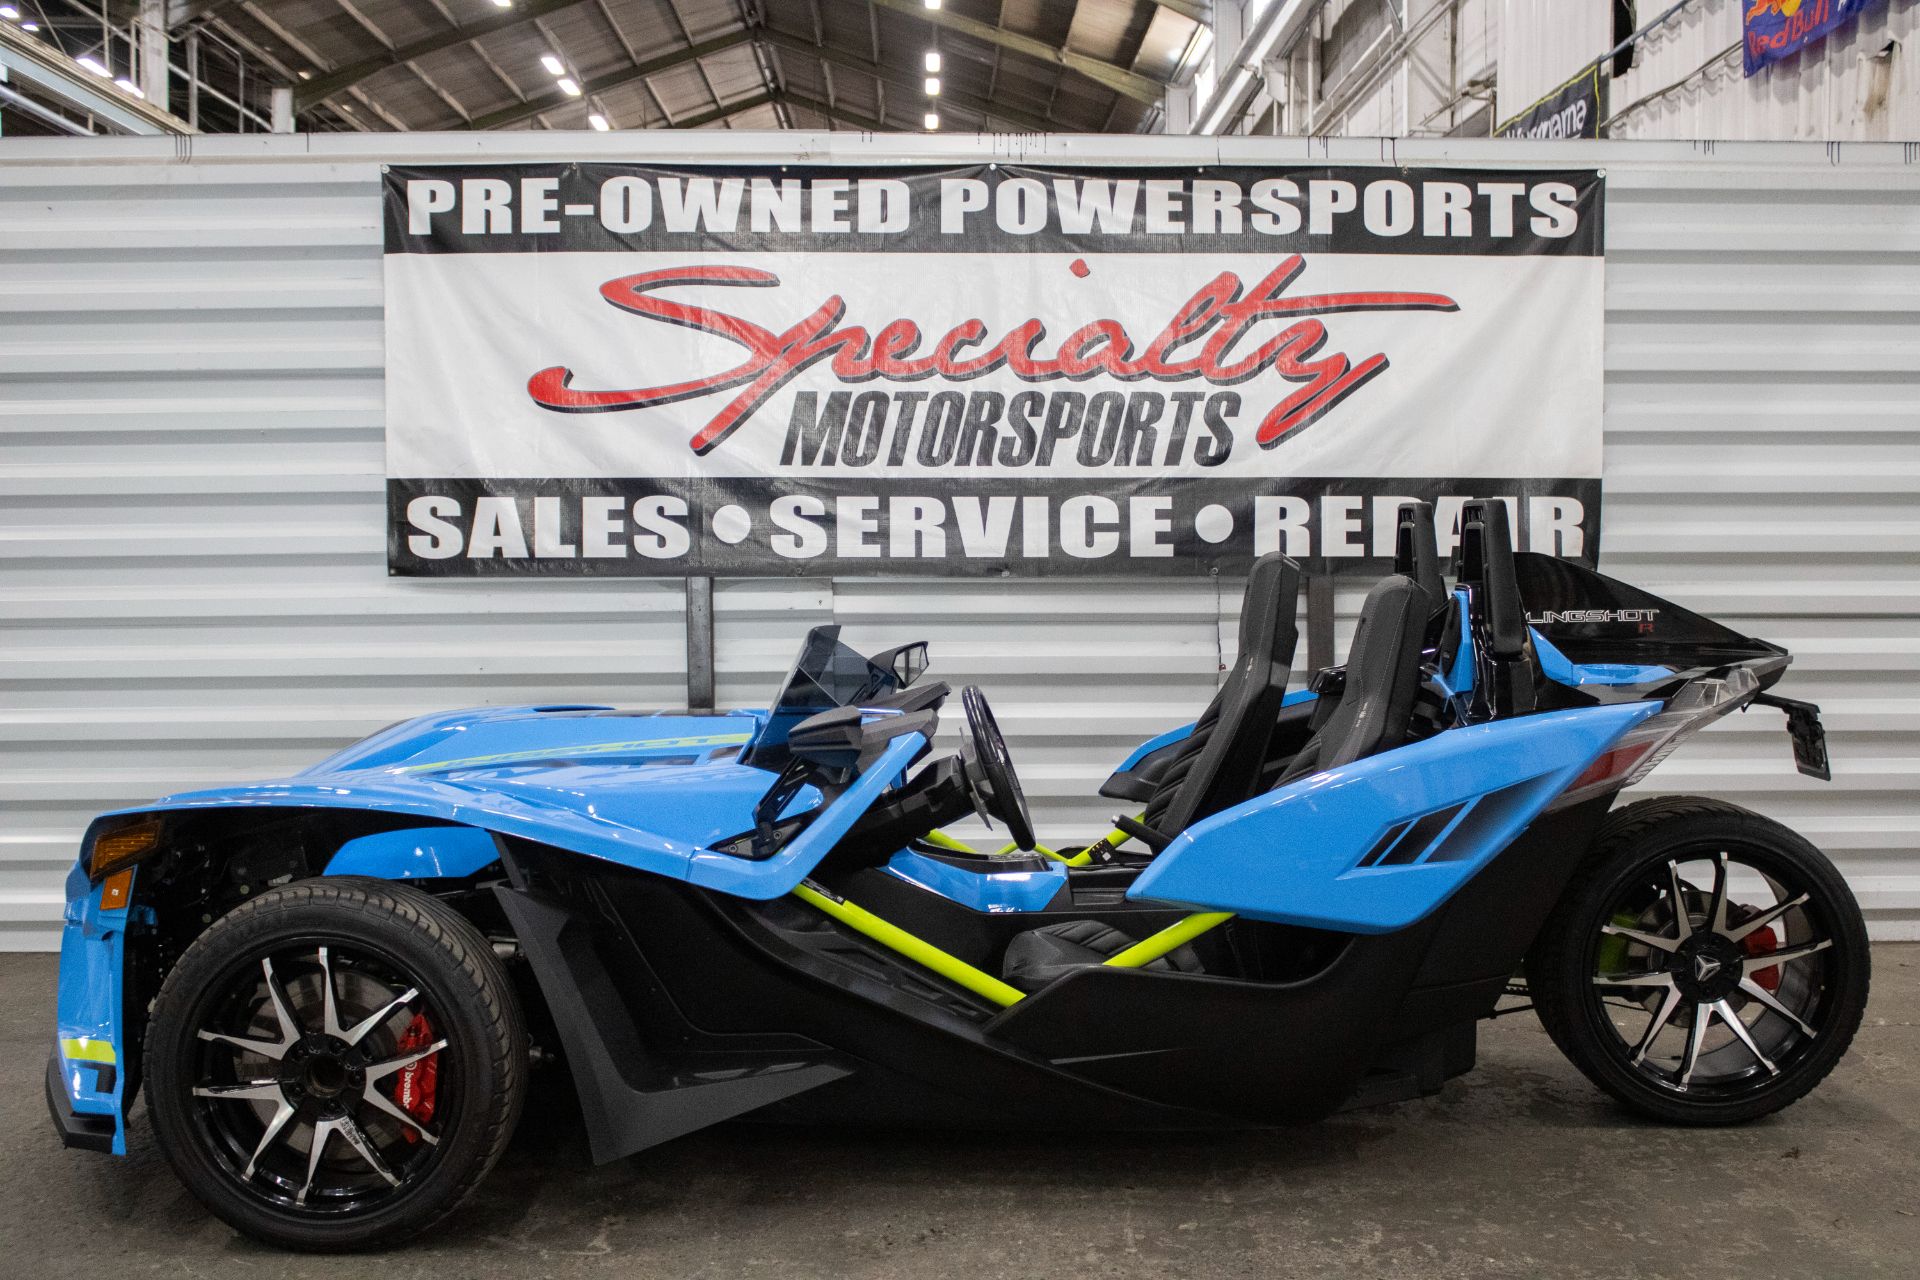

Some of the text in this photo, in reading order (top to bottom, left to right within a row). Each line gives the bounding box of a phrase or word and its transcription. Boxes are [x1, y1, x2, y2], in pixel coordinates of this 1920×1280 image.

[406, 175, 1579, 239] PRE-OWNED POWERSPORTS
[527, 253, 1461, 457] Specialty
[781, 389, 1242, 468] MOTORSPORTS
[406, 494, 691, 560] SALES
[769, 494, 1175, 560] SERVICE
[1524, 609, 1660, 624] LINGSHOT
